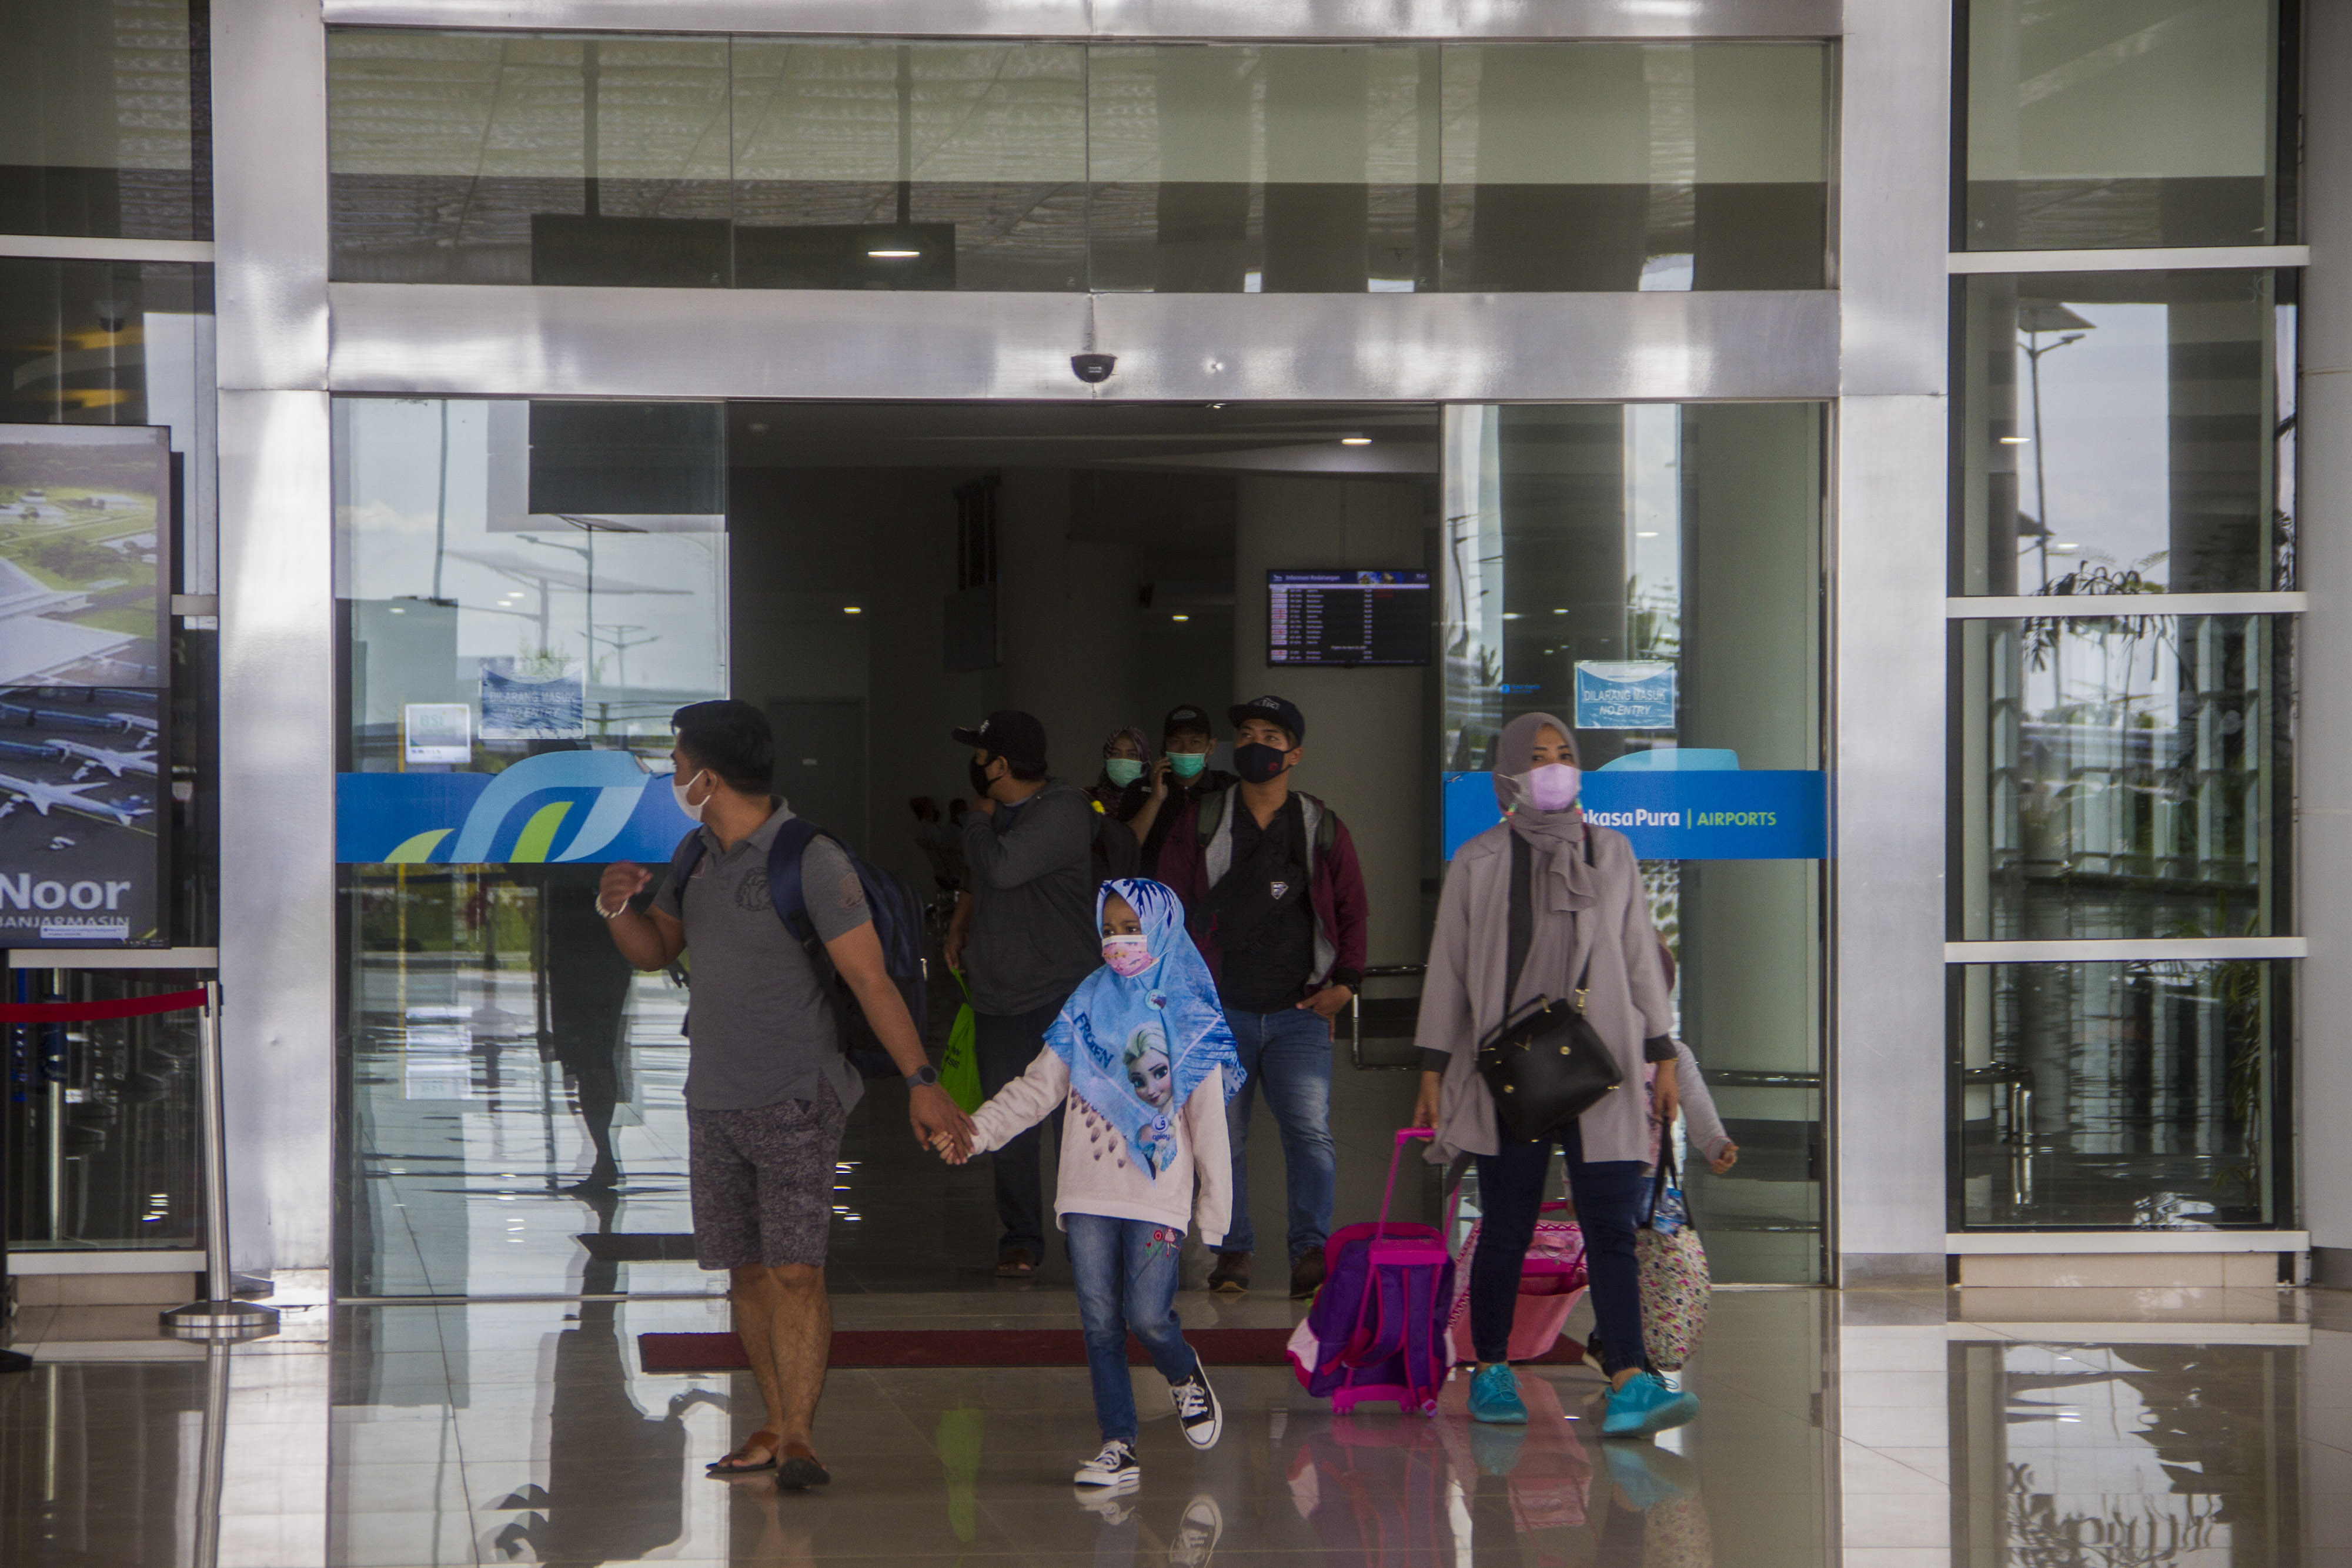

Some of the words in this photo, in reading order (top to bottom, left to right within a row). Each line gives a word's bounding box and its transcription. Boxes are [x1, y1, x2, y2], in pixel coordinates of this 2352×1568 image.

[1583, 690, 1631, 701] DILARANG
[1632, 690, 1666, 701] MASUK
[1599, 706, 1615, 715] NO
[1616, 706, 1651, 715] ENTRY
[1697, 812, 1777, 826] AIRPORTS
[0, 872, 131, 910] Noor
